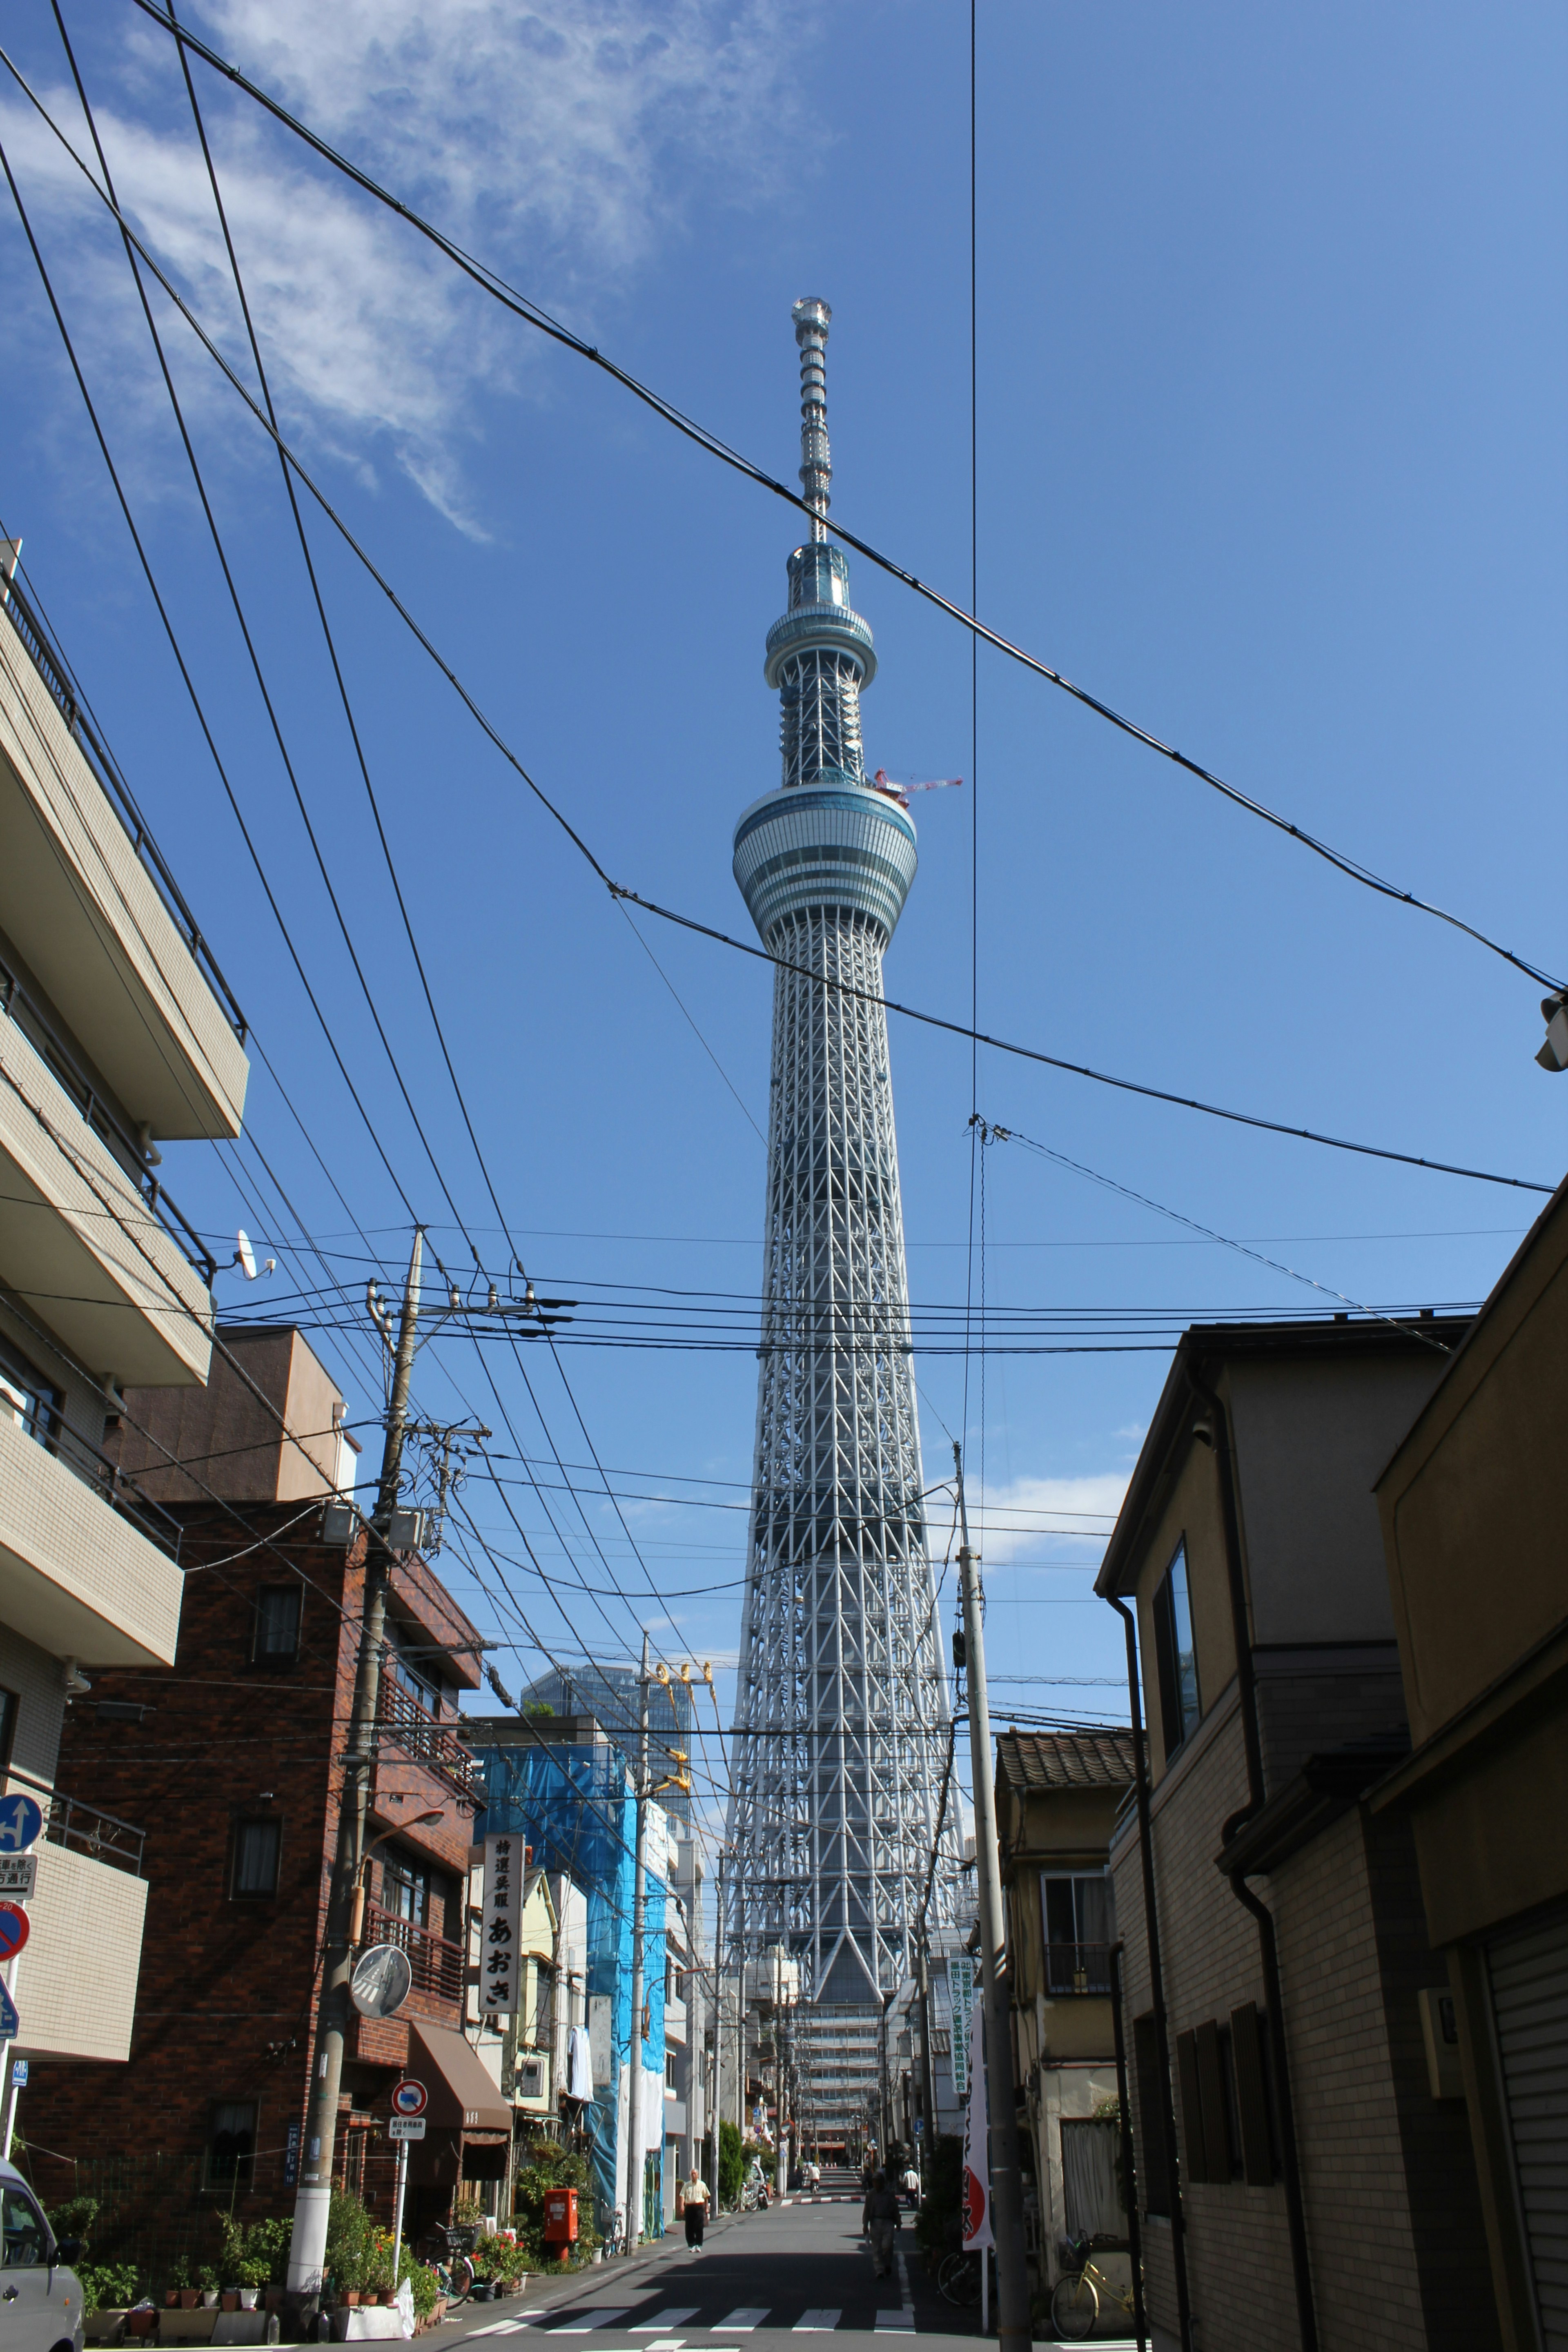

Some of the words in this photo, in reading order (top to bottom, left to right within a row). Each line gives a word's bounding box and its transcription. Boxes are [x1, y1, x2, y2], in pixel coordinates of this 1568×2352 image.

[0, 1859, 32, 1870] 車を除く
[494, 1839, 511, 1908] 特選呉服
[486, 1916, 512, 2005] あおき
